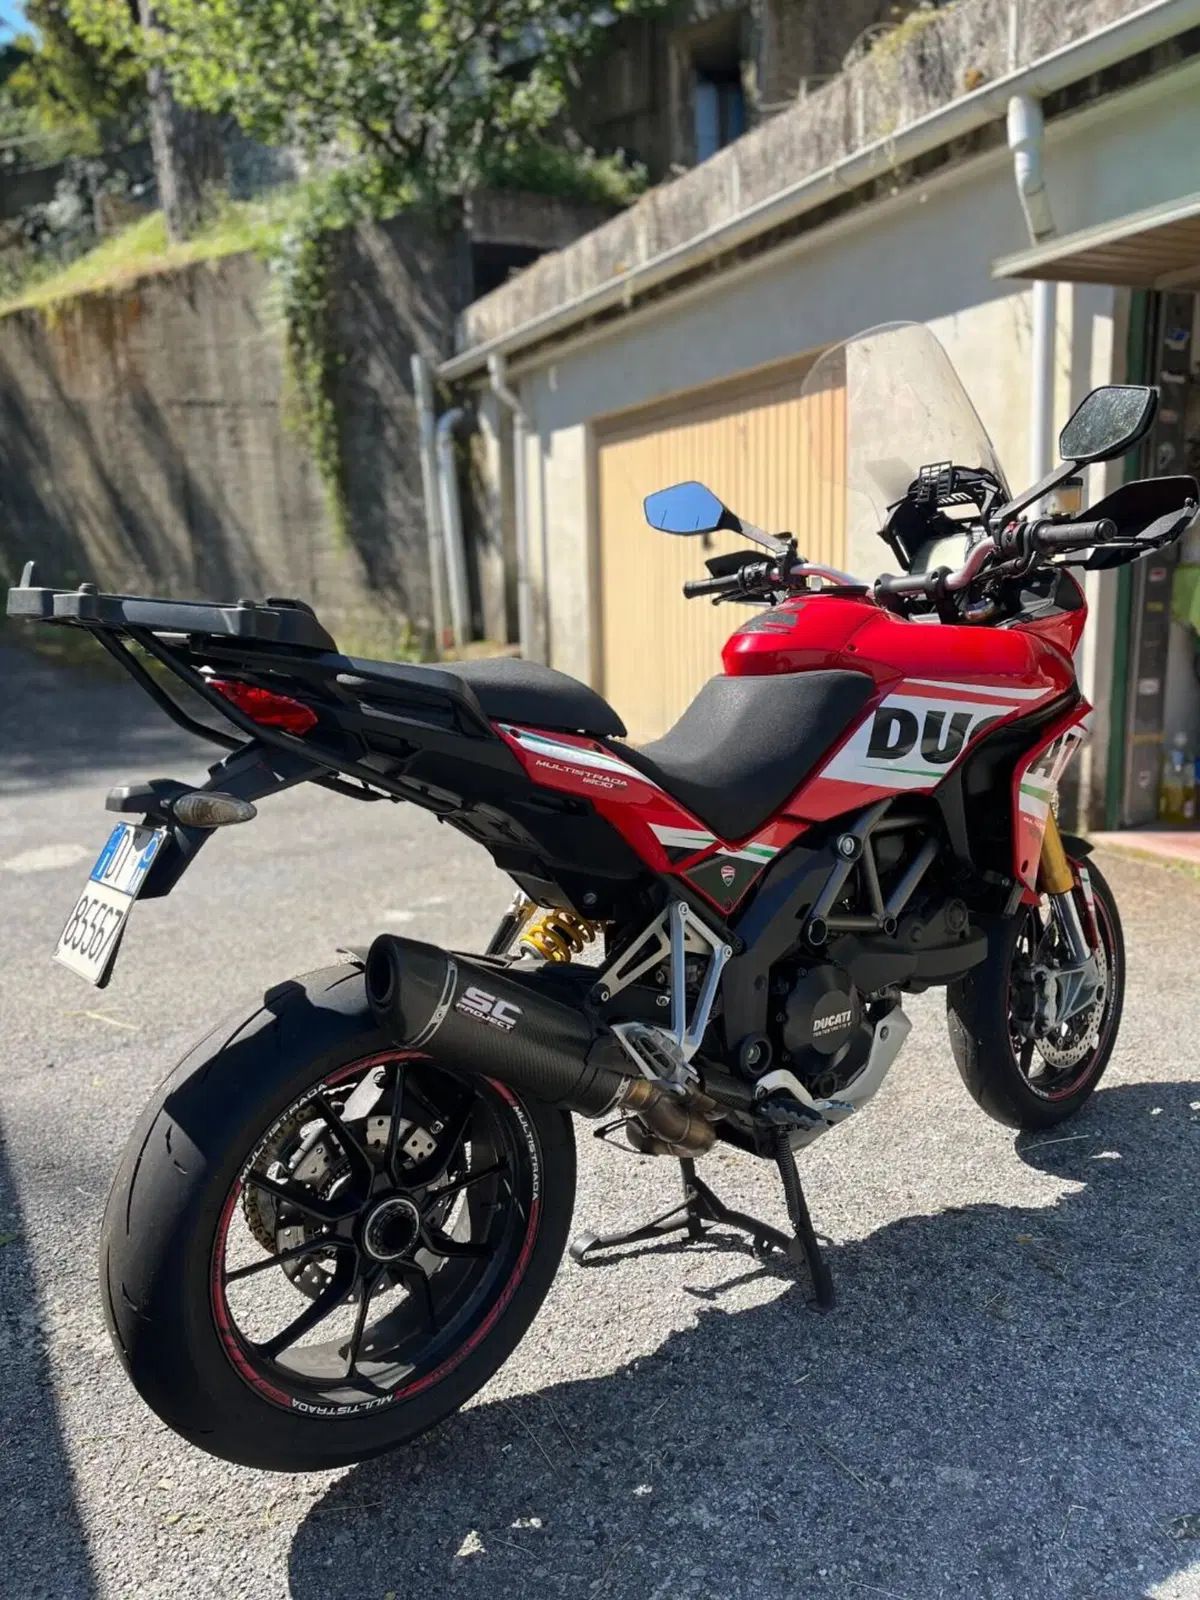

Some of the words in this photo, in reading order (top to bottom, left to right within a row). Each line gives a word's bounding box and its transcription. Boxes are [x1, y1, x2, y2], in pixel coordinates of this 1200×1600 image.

[535, 760, 628, 786] MULTISTRADA
[63, 896, 123, 963] 85567
[455, 1003, 514, 1030] PROJECT
[461, 987, 523, 1025] SC
[812, 1010, 852, 1031] DUCATI
[512, 1106, 540, 1201] MULTISTRADA
[292, 1394, 394, 1415] MULTISTRADA
